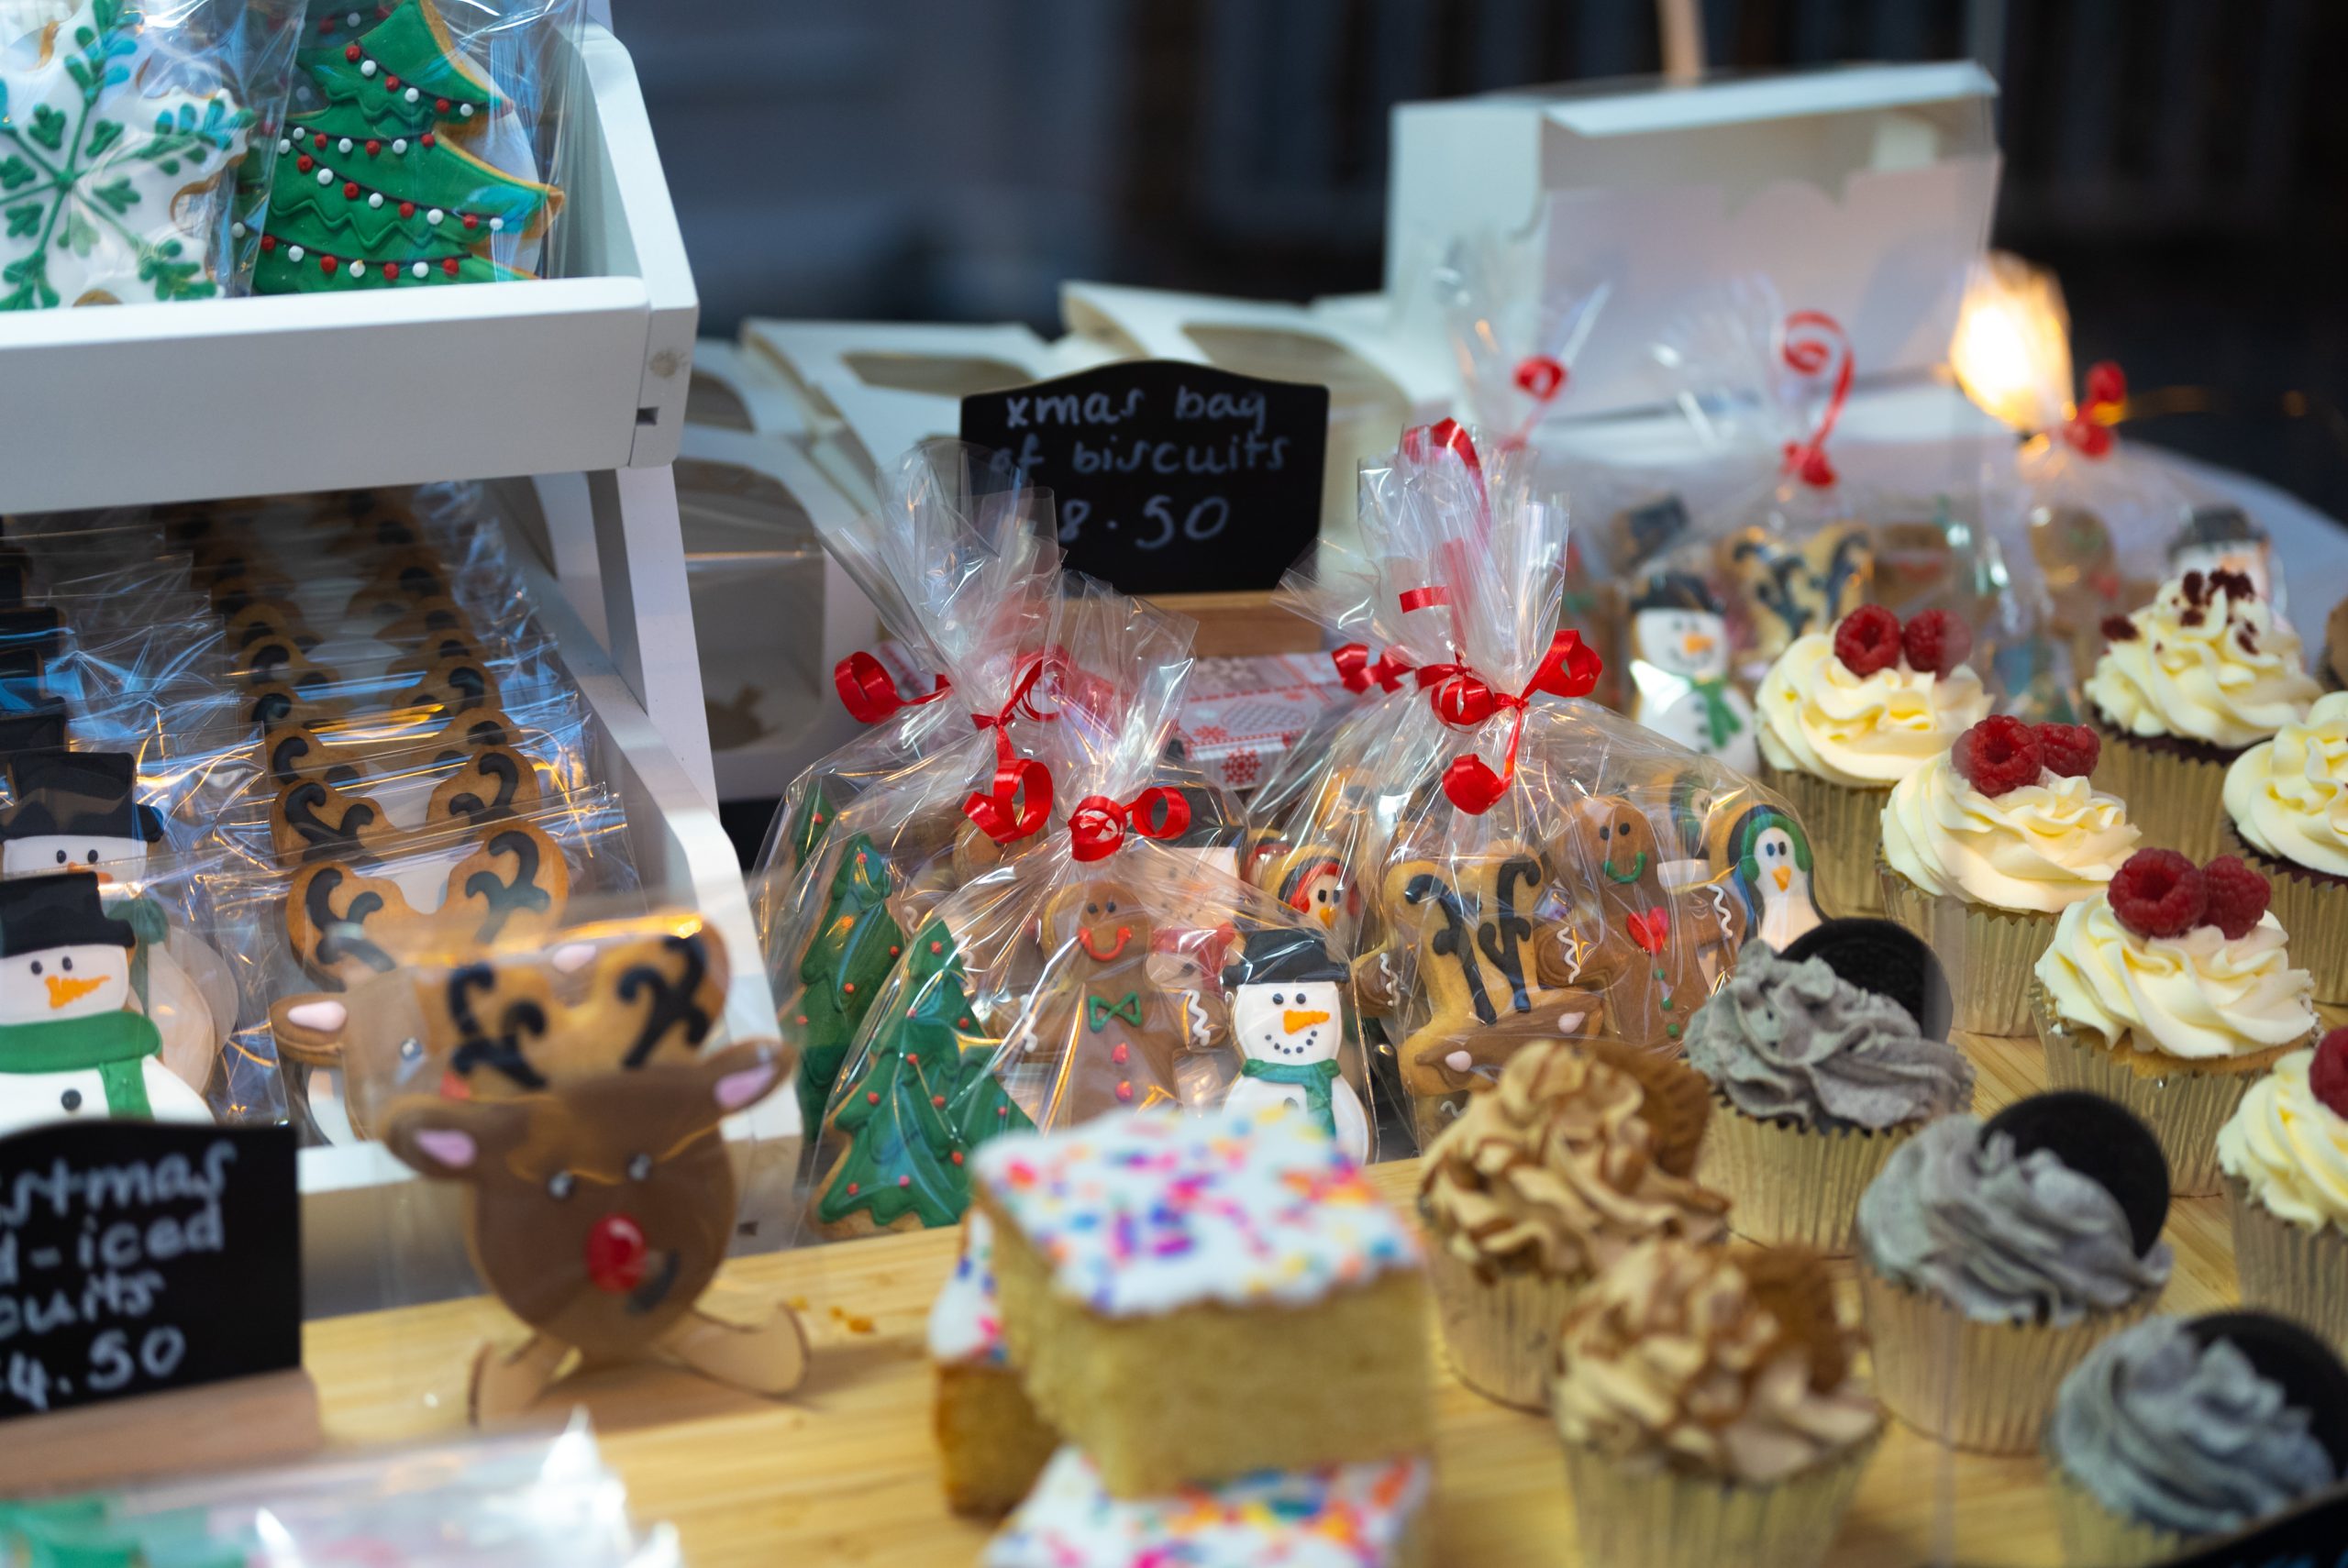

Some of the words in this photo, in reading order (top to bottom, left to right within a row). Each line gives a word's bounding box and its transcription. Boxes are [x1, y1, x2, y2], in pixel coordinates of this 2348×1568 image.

[1006, 387, 1146, 428] xmas
[1175, 385, 1267, 435] bag
[989, 433, 1045, 481] of
[1073, 434, 1290, 475] biscuits
[0, 1139, 238, 1227] stmas
[0, 1326, 186, 1411] 4.50
